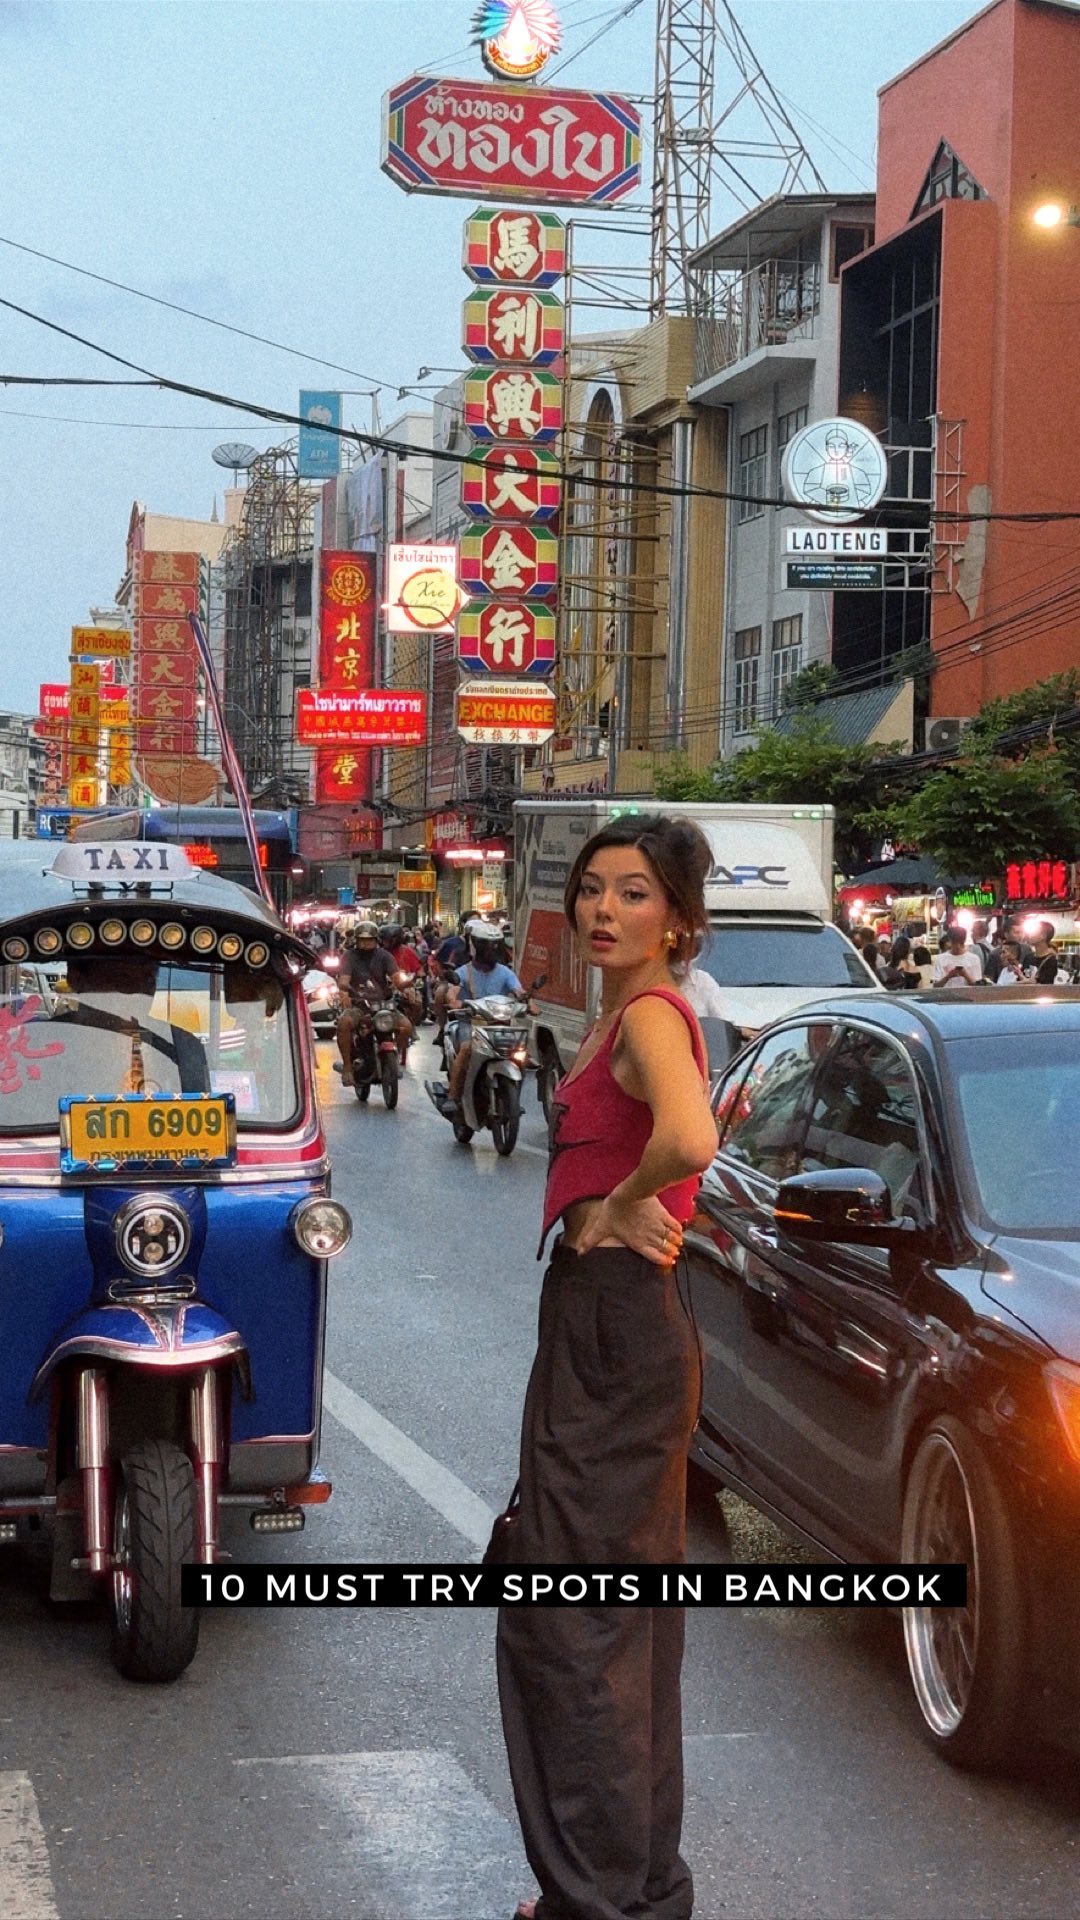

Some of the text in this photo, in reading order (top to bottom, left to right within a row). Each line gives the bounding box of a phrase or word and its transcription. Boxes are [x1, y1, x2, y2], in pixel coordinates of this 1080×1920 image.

[424, 87, 524, 123] ห้างทอง
[416, 105, 615, 182] ทองใบ
[792, 532, 881, 550] LAOTENG
[460, 702, 554, 723] EXCHANGE
[85, 848, 169, 871] TAXI
[85, 1106, 222, 1139] สก 6909
[89, 1148, 210, 1160] กรงเทพมหานคร
